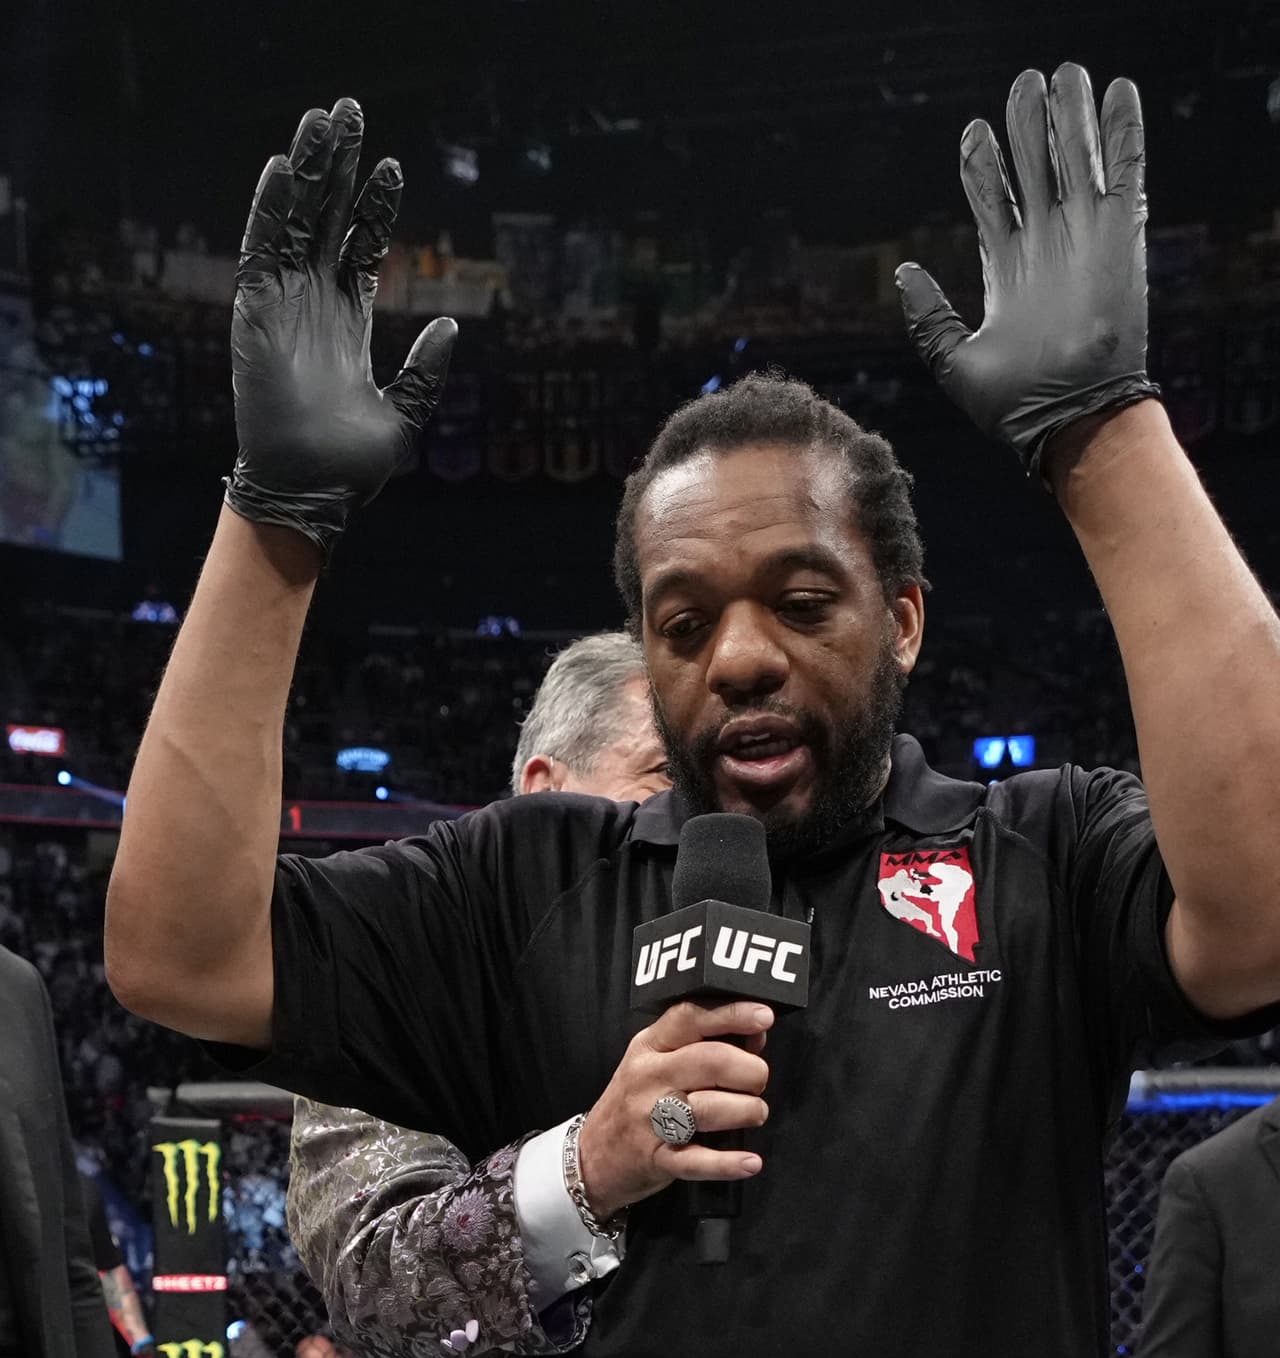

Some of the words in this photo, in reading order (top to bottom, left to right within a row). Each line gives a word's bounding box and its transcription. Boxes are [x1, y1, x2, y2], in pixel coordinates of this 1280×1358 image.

[885, 851, 962, 867] MMA
[635, 925, 702, 986] UFC
[712, 926, 803, 983] UFC
[869, 980, 929, 999] NEVADA
[931, 969, 1002, 988] ATHLETIC
[888, 985, 984, 1009] COMMISSION
